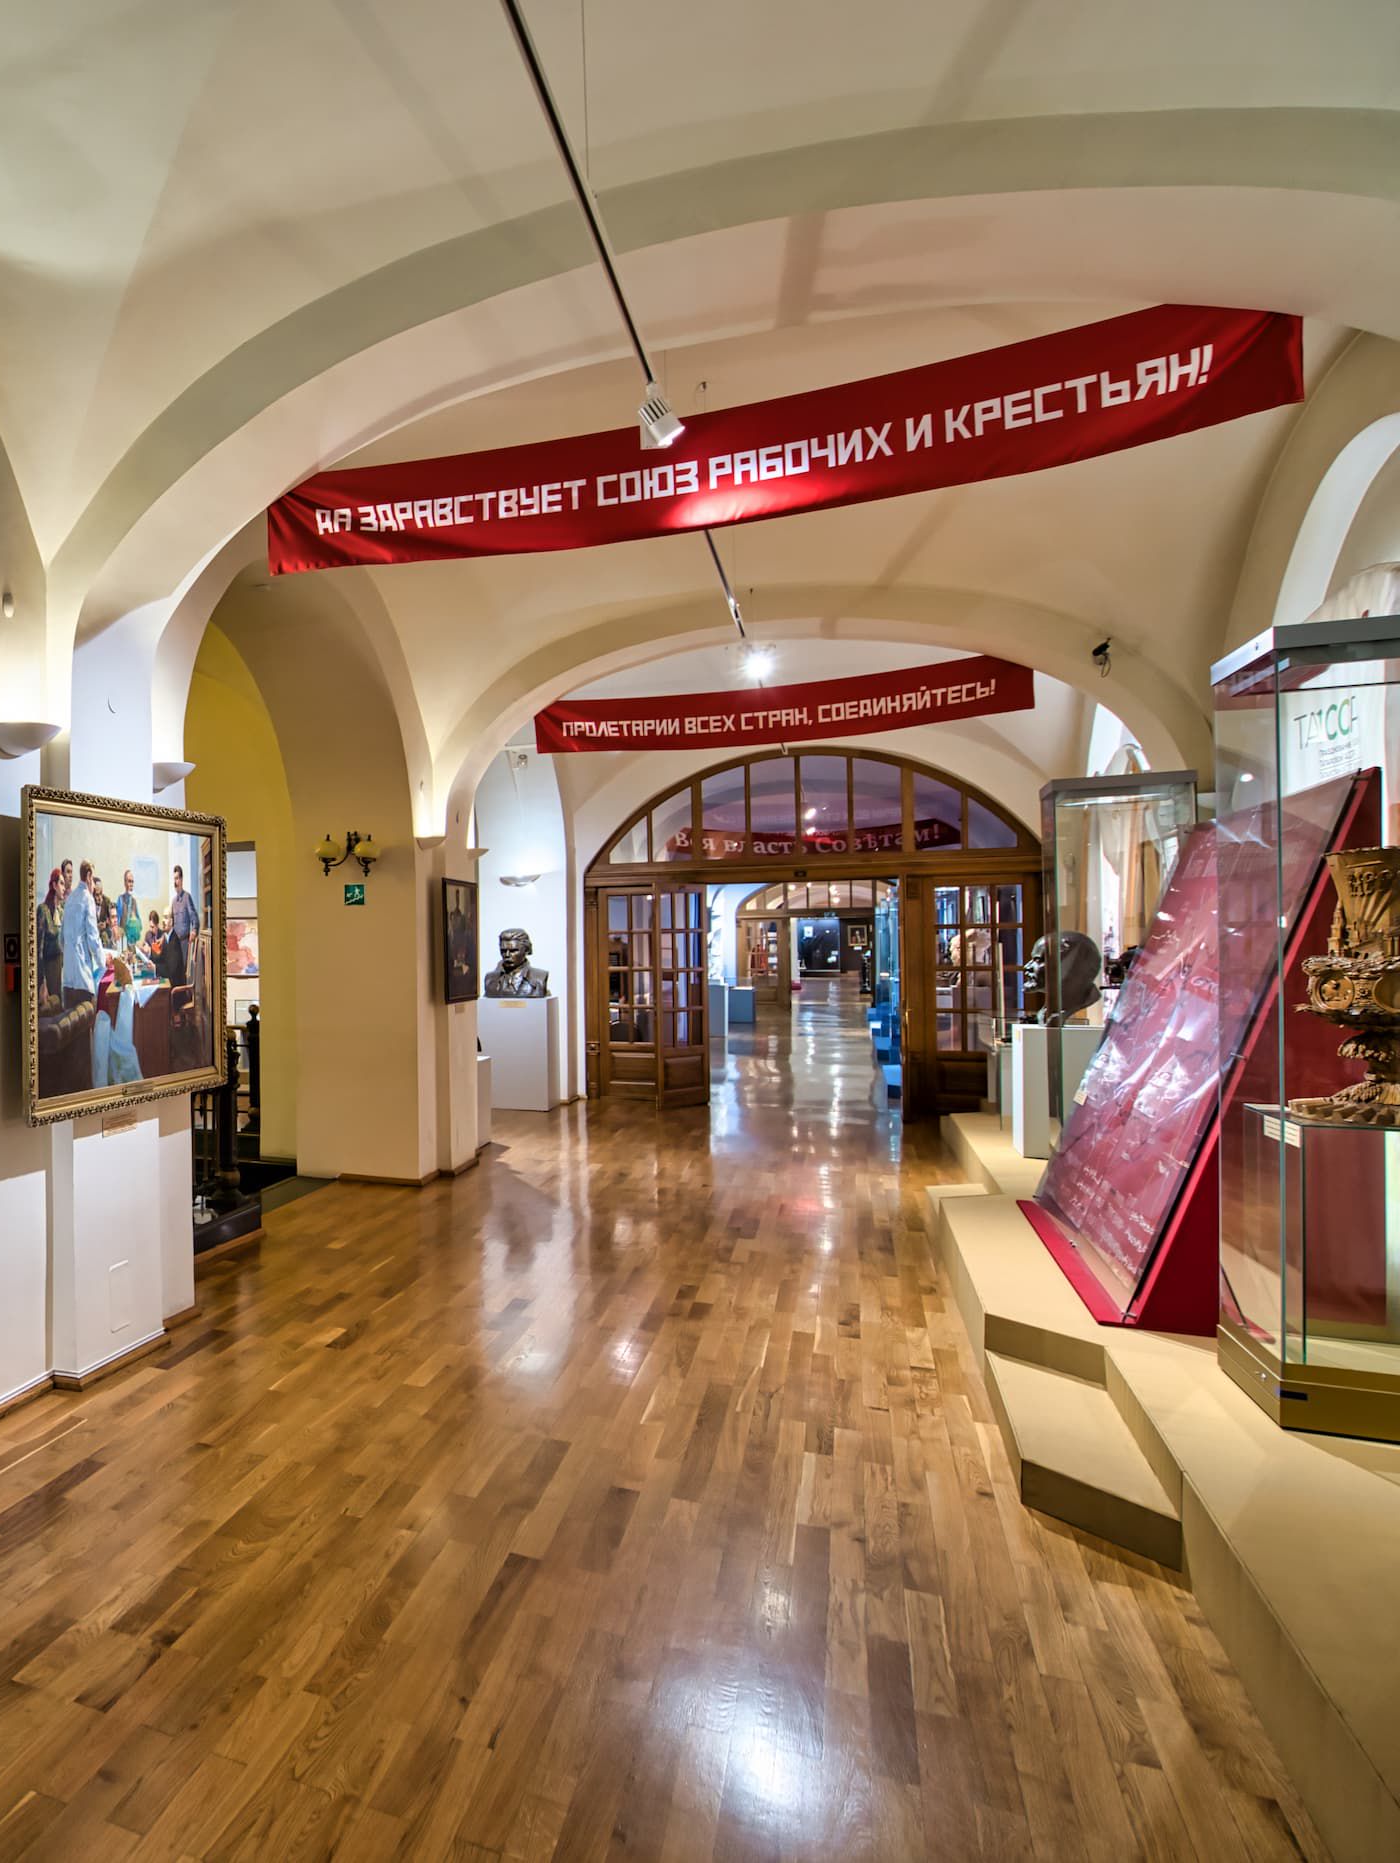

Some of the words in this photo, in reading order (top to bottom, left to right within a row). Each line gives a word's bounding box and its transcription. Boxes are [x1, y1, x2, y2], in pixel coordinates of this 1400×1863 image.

[315, 508, 352, 536] ДА
[358, 478, 588, 533] ЗДРАВСТВУЕТ
[596, 459, 699, 507] СОЮЗ
[708, 422, 894, 490] РАБОЧИХ
[904, 414, 934, 453] И
[943, 343, 1215, 445] КРЕСТЬЯН!
[562, 717, 680, 737] ПРОЛЕТАРИИ
[684, 714, 736, 735] ВСЕХ
[740, 707, 814, 731] СТРАН,
[817, 678, 997, 723] СОЕДИНЯЙТЕСЬ!
[674, 832, 716, 851] Вя
